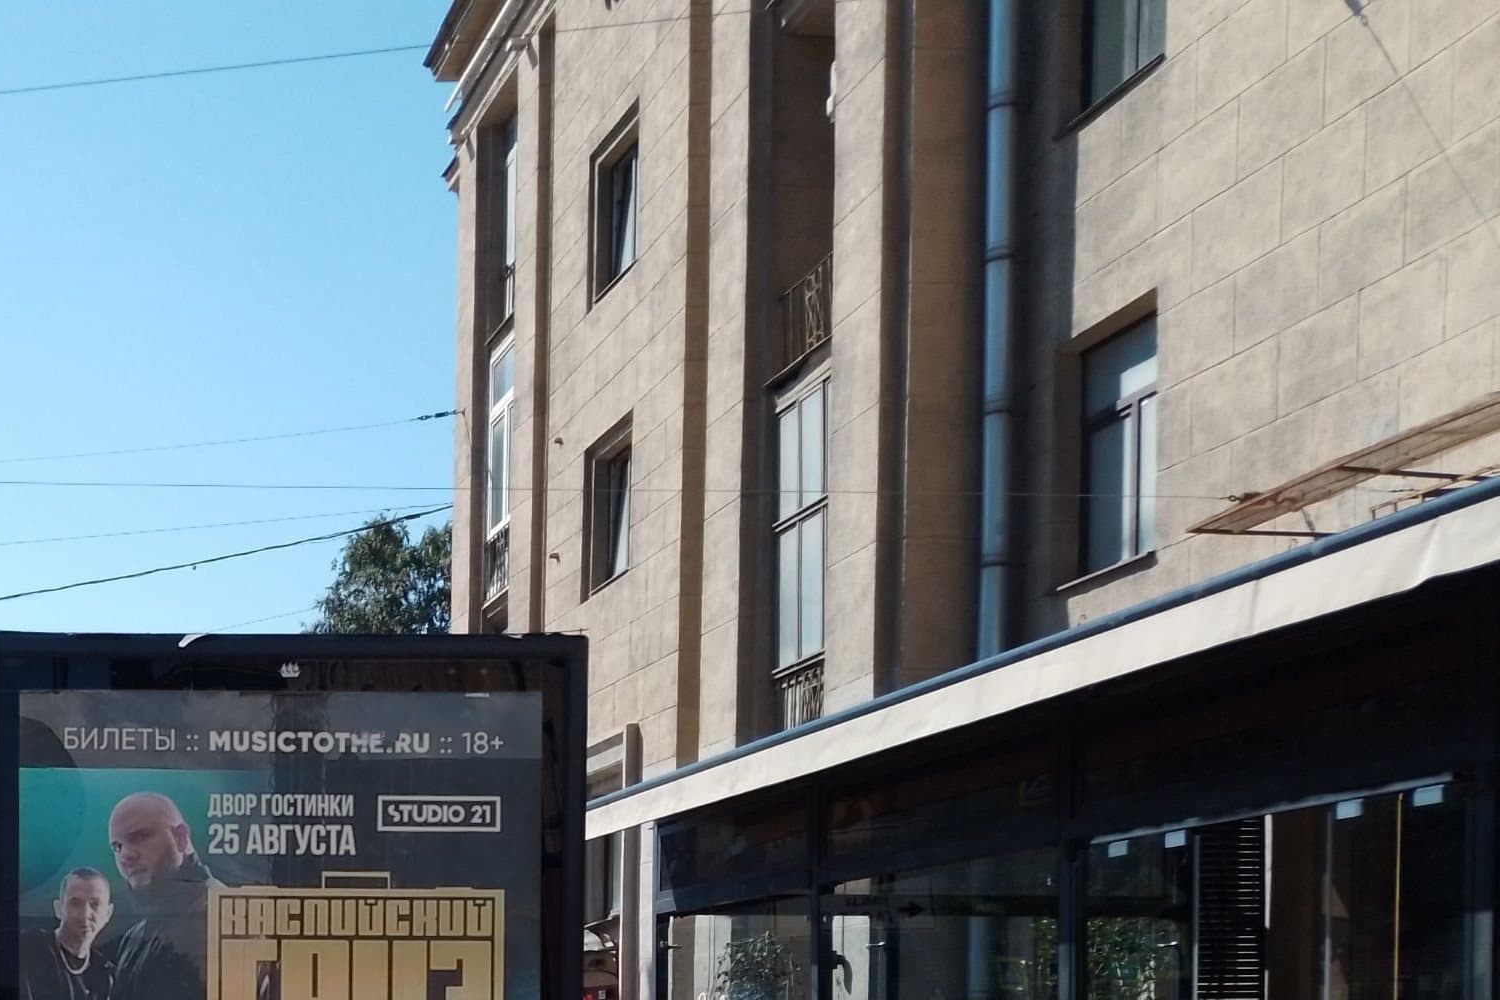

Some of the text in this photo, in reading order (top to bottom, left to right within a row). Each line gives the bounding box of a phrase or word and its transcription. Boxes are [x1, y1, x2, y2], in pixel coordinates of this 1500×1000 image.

[63, 727, 176, 751] БИЛЕТЫ
[208, 731, 430, 754] MUSICTOTHE.RU
[461, 731, 504, 755] 18+
[207, 793, 354, 818] ДВОР ГОСТИНКИ
[387, 804, 491, 824] STUDIO 21
[208, 823, 356, 856] 25 АВГУСТА
[220, 899, 493, 936] КАСПИЙСКИЙ
